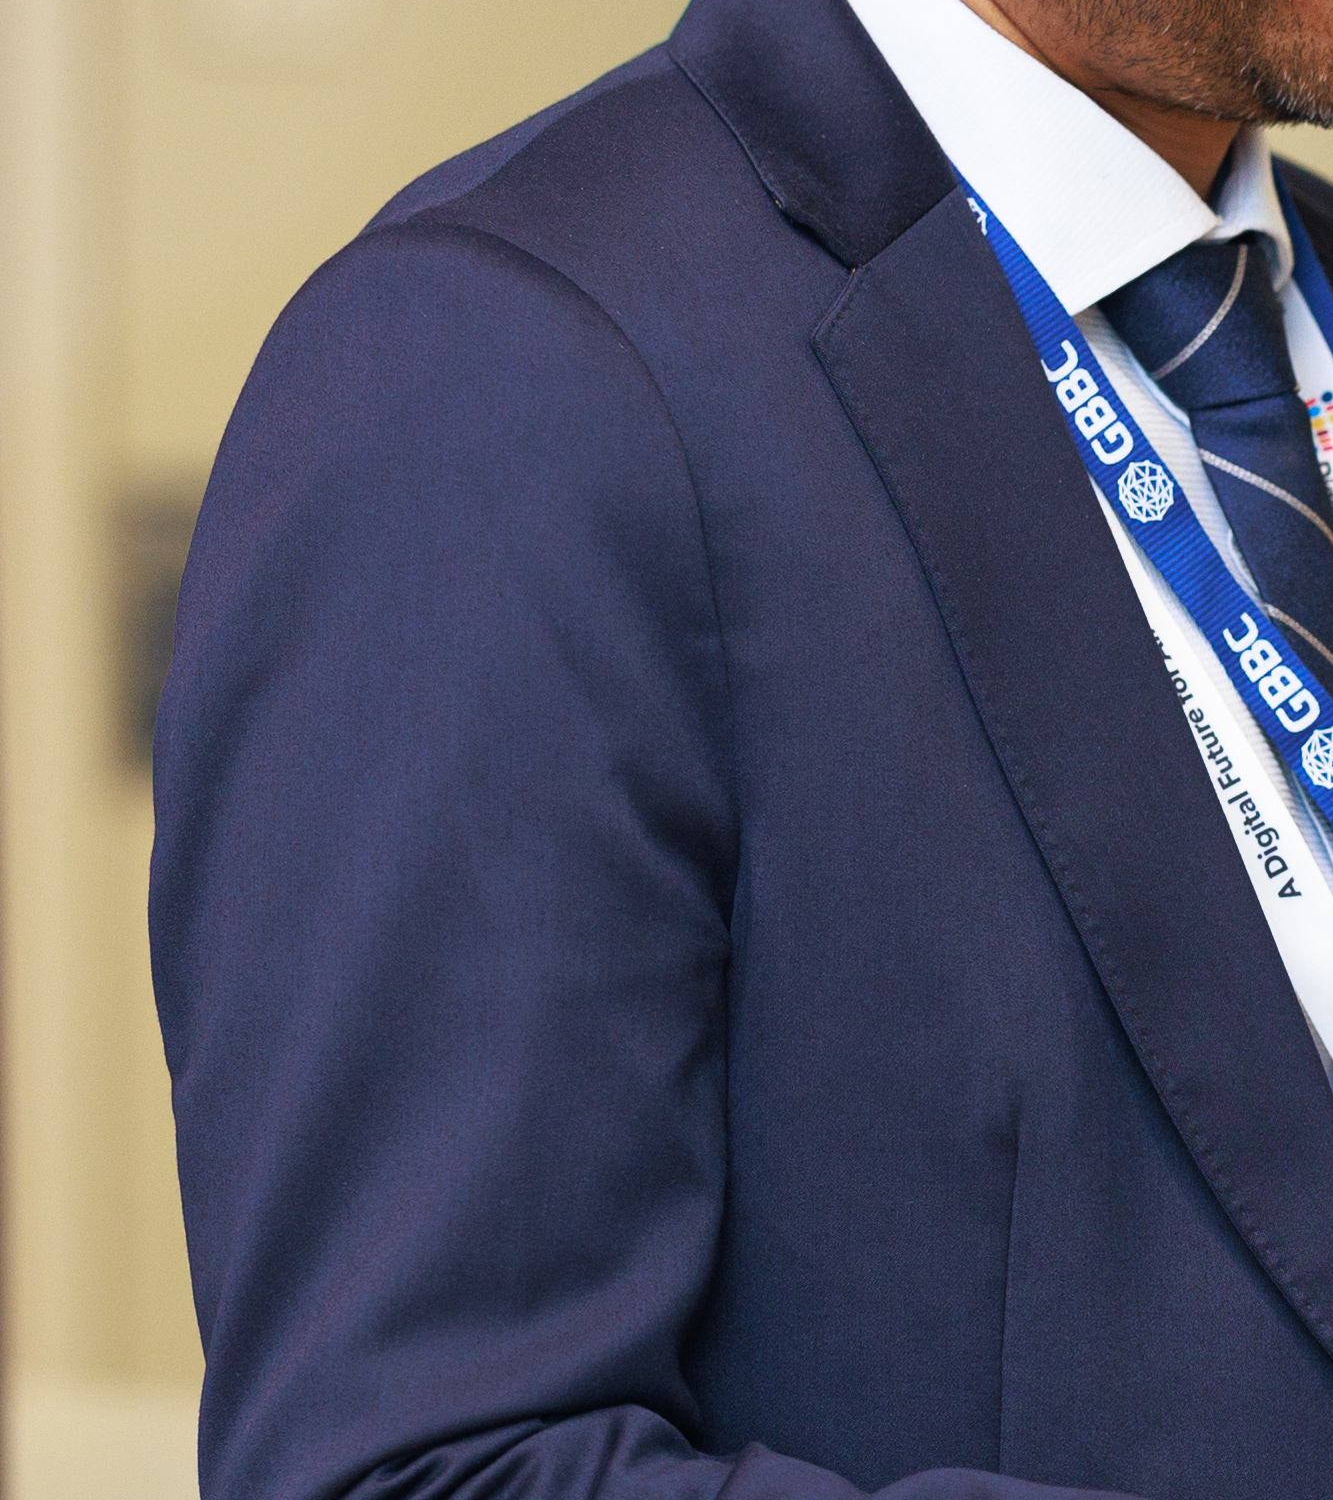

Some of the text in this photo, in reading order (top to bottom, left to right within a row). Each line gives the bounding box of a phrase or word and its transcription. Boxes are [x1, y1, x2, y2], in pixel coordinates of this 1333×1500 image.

[1040, 339, 1135, 466] GBBC
[1222, 611, 1321, 734] GBBC
[1187, 707, 1241, 790] Future
[1227, 790, 1289, 879] Digital
[1277, 877, 1302, 900] A
